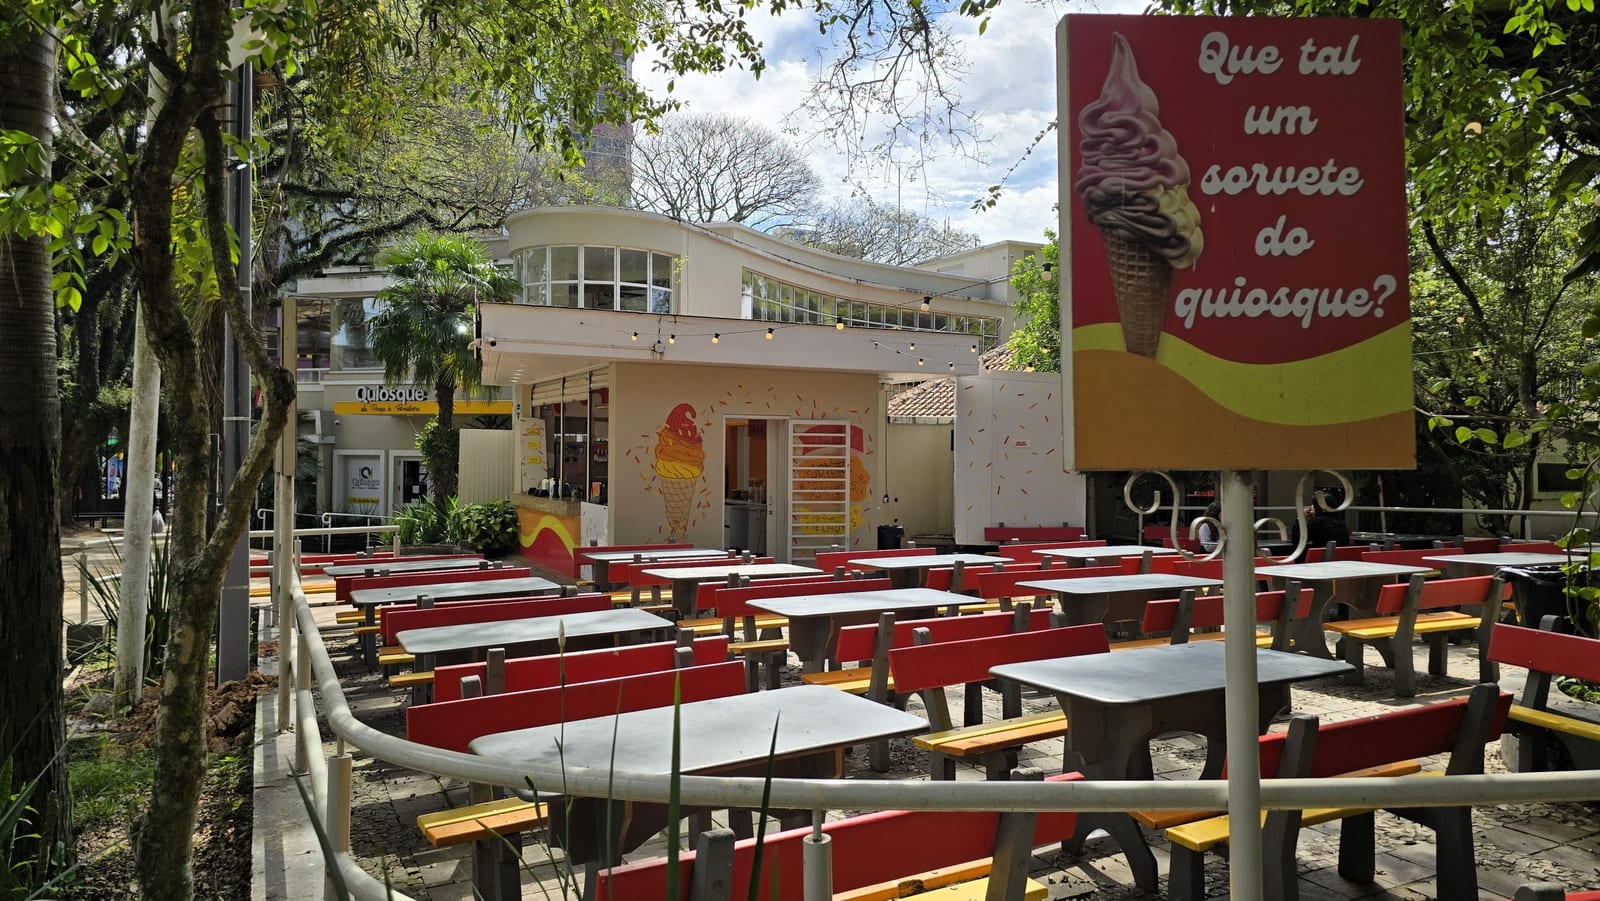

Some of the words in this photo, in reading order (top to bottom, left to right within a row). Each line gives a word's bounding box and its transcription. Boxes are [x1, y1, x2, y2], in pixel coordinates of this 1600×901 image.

[1198, 31, 1283, 85] Que
[1299, 34, 1361, 76] tal
[1244, 104, 1318, 135] um
[1201, 158, 1364, 197] sorvete
[1254, 214, 1315, 257] do
[1174, 274, 1397, 329] quiosque?
[356, 385, 425, 404] Quiosque
